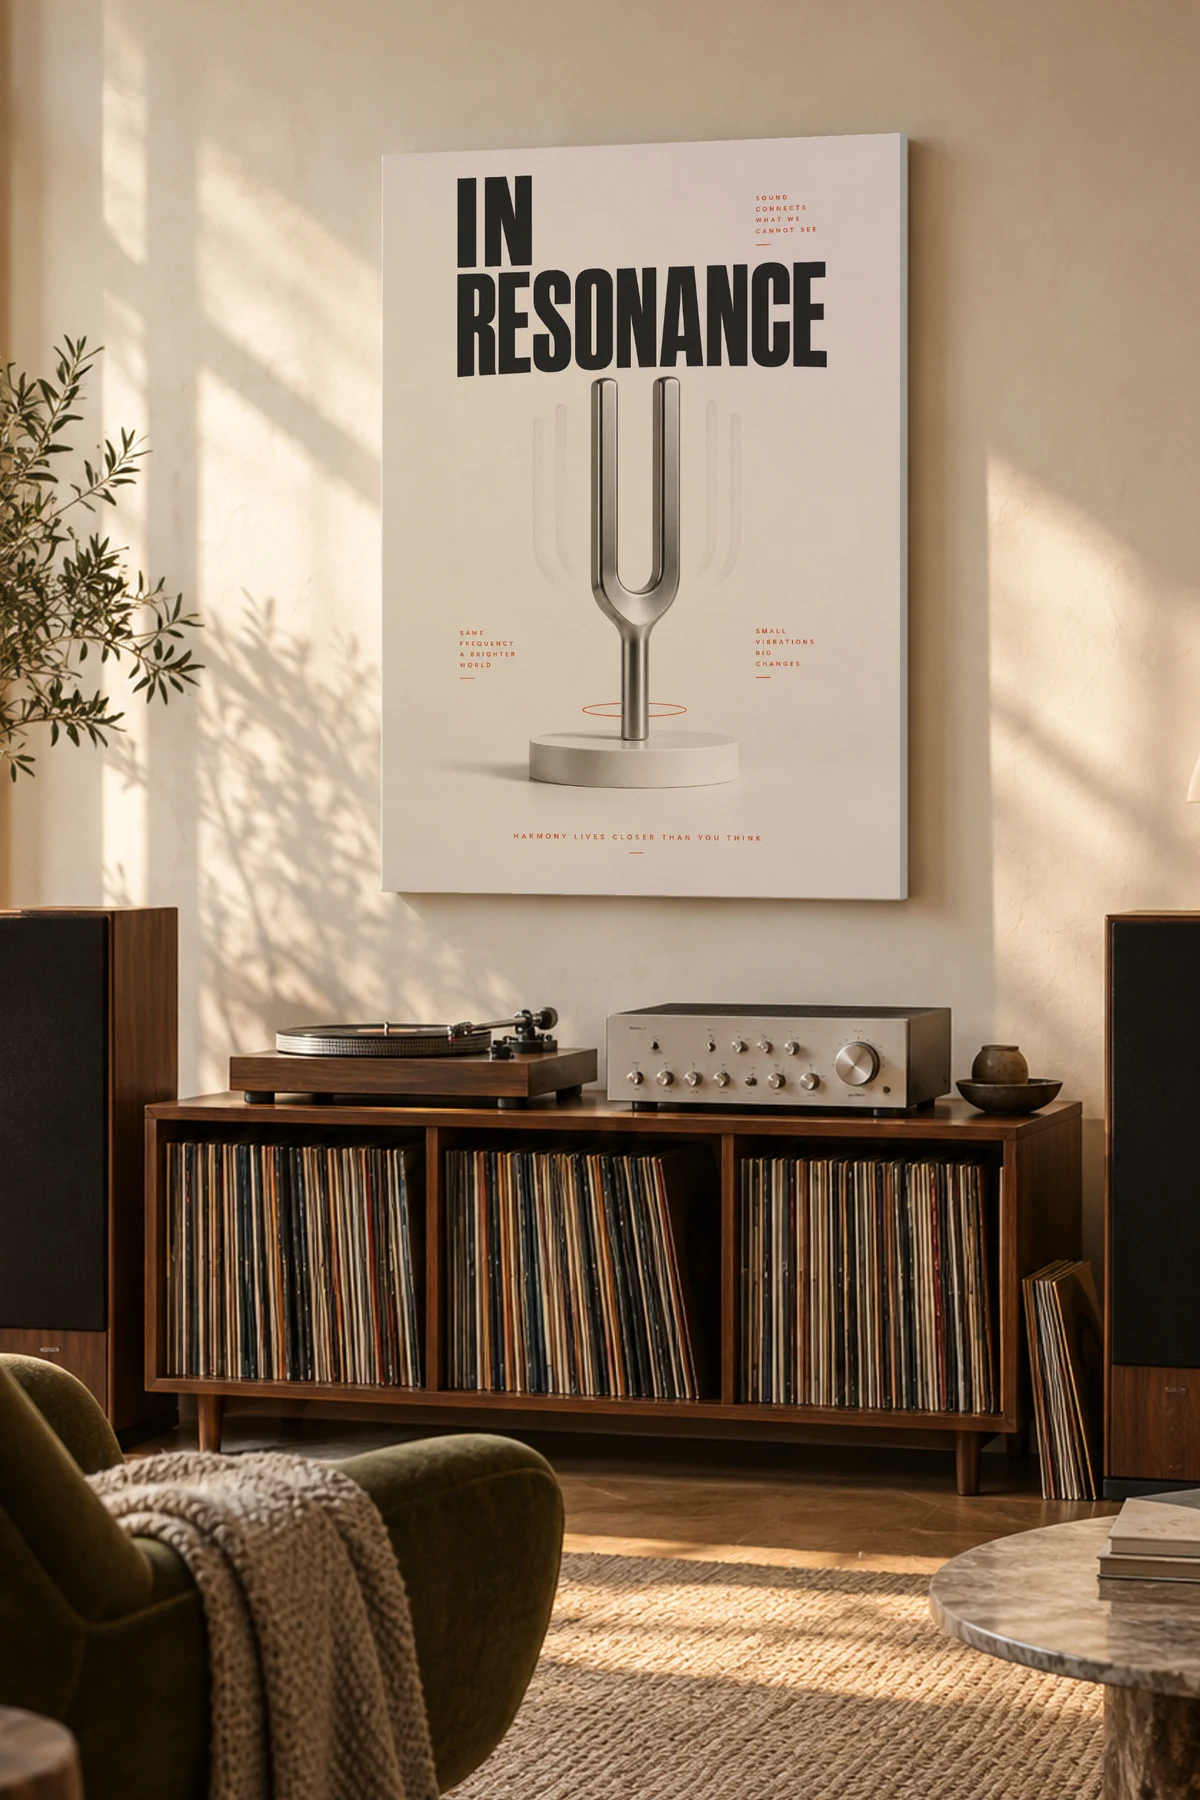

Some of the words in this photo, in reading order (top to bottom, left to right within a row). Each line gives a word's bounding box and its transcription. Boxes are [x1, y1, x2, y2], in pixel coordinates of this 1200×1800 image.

[457, 175, 533, 268] IN
[457, 261, 828, 378] RESONANCE
[513, 832, 568, 841] HARMONY
[573, 833, 606, 841] LIVES
[612, 833, 655, 842] CLOSER
[661, 834, 692, 842] THAN
[697, 834, 720, 842] YOU
[726, 834, 762, 843] THINK
